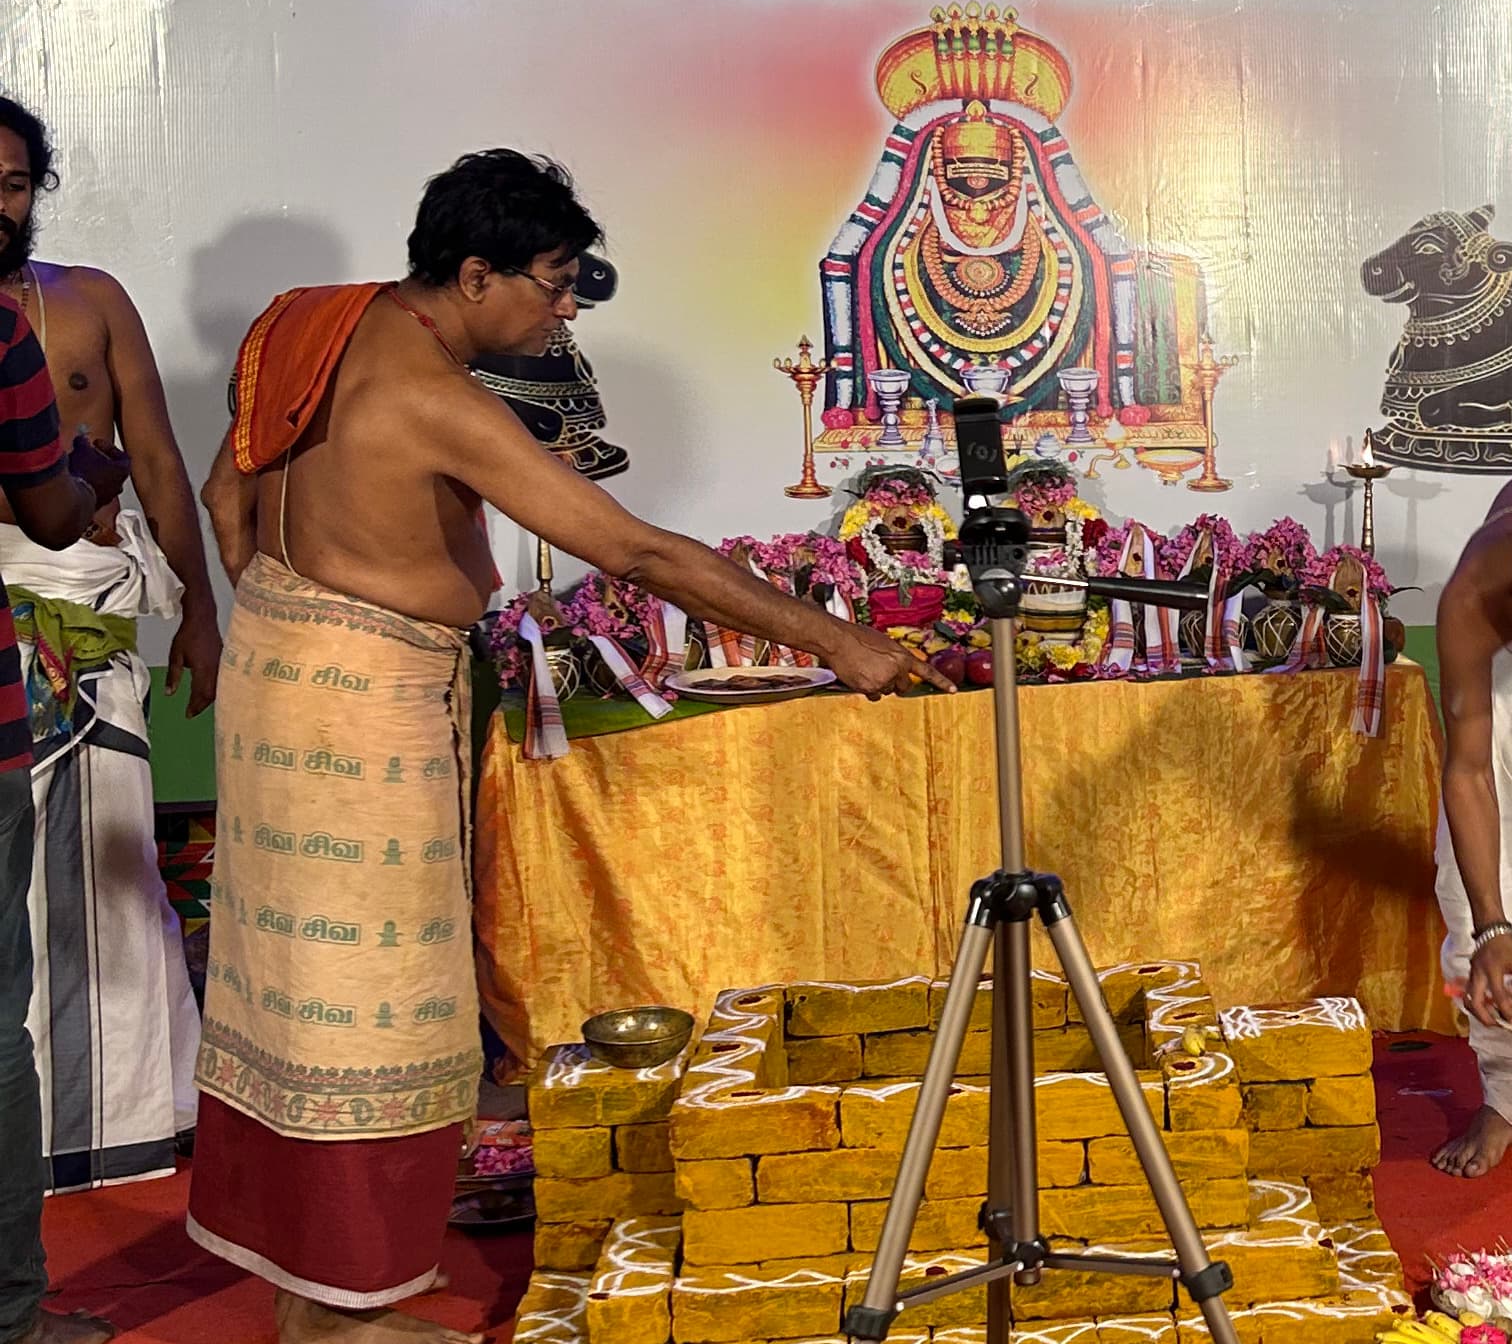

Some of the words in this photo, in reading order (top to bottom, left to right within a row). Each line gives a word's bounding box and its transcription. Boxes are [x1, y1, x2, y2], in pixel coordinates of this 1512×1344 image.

[262, 657, 299, 682] சிவ
[310, 665, 370, 693] சிவ
[253, 743, 295, 768] சிவ
[303, 750, 362, 777] சிவ
[254, 827, 293, 851] சிவ
[302, 834, 360, 860] சிவ
[256, 910, 294, 934] சிவ
[301, 919, 358, 942] சிவ
[299, 1001, 354, 1025] சிவ
